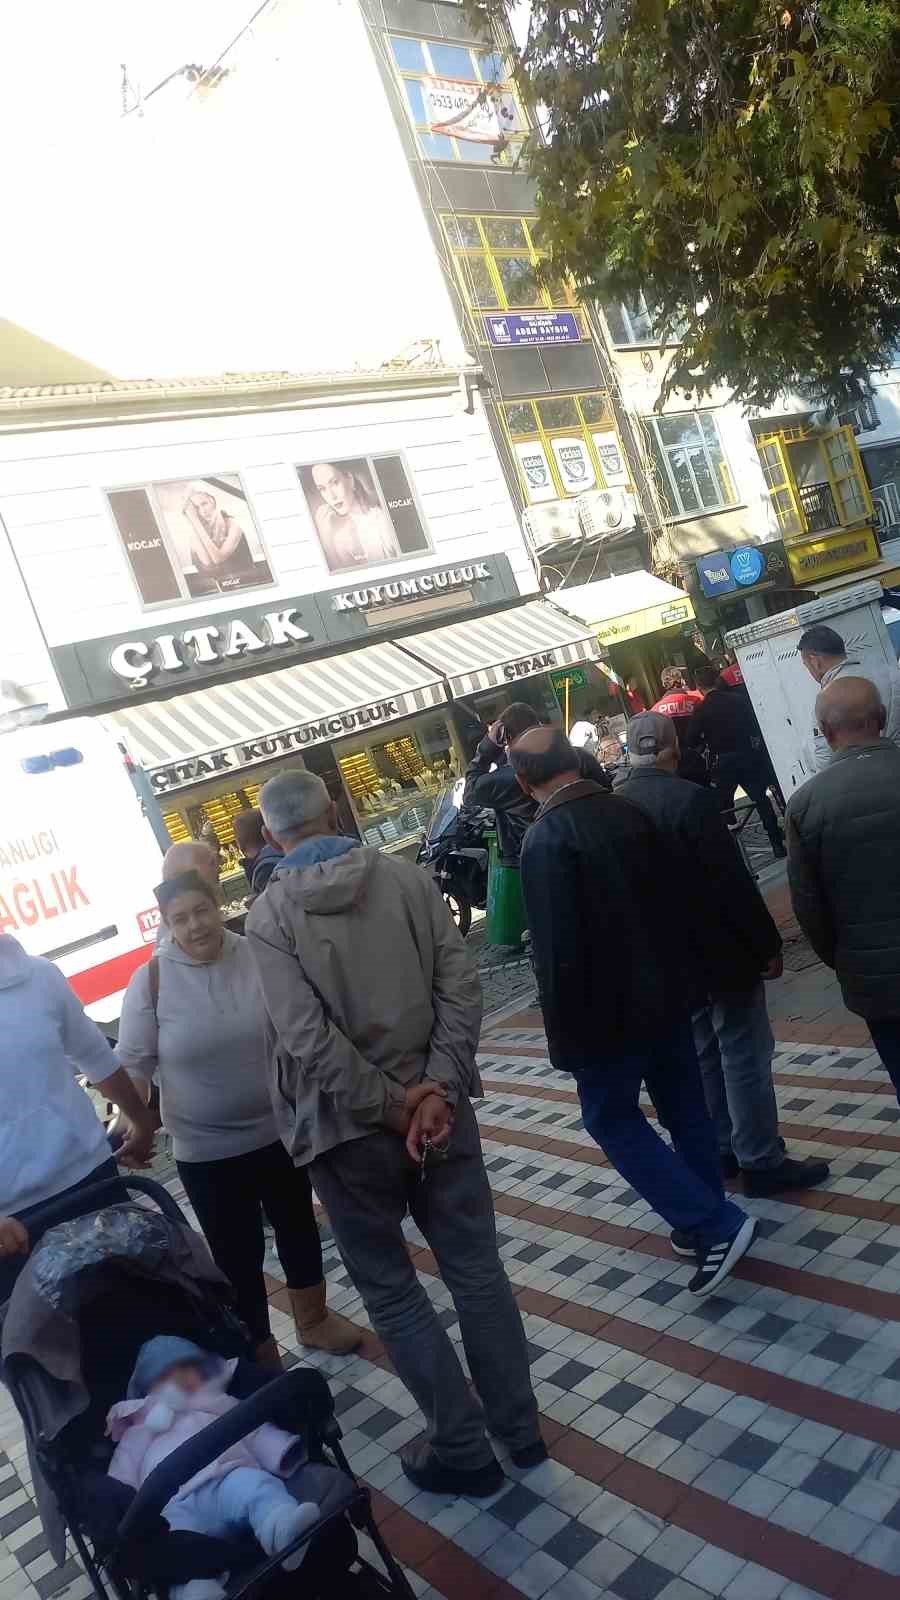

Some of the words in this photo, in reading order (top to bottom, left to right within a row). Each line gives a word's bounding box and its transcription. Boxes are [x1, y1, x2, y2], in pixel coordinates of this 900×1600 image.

[110, 606, 311, 688] ÇITAK
[332, 562, 490, 612] KUYUMCULUK
[503, 650, 556, 682] ÇITAK
[150, 751, 232, 793] ÇITAK
[241, 698, 400, 764] KUYUMCULUK
